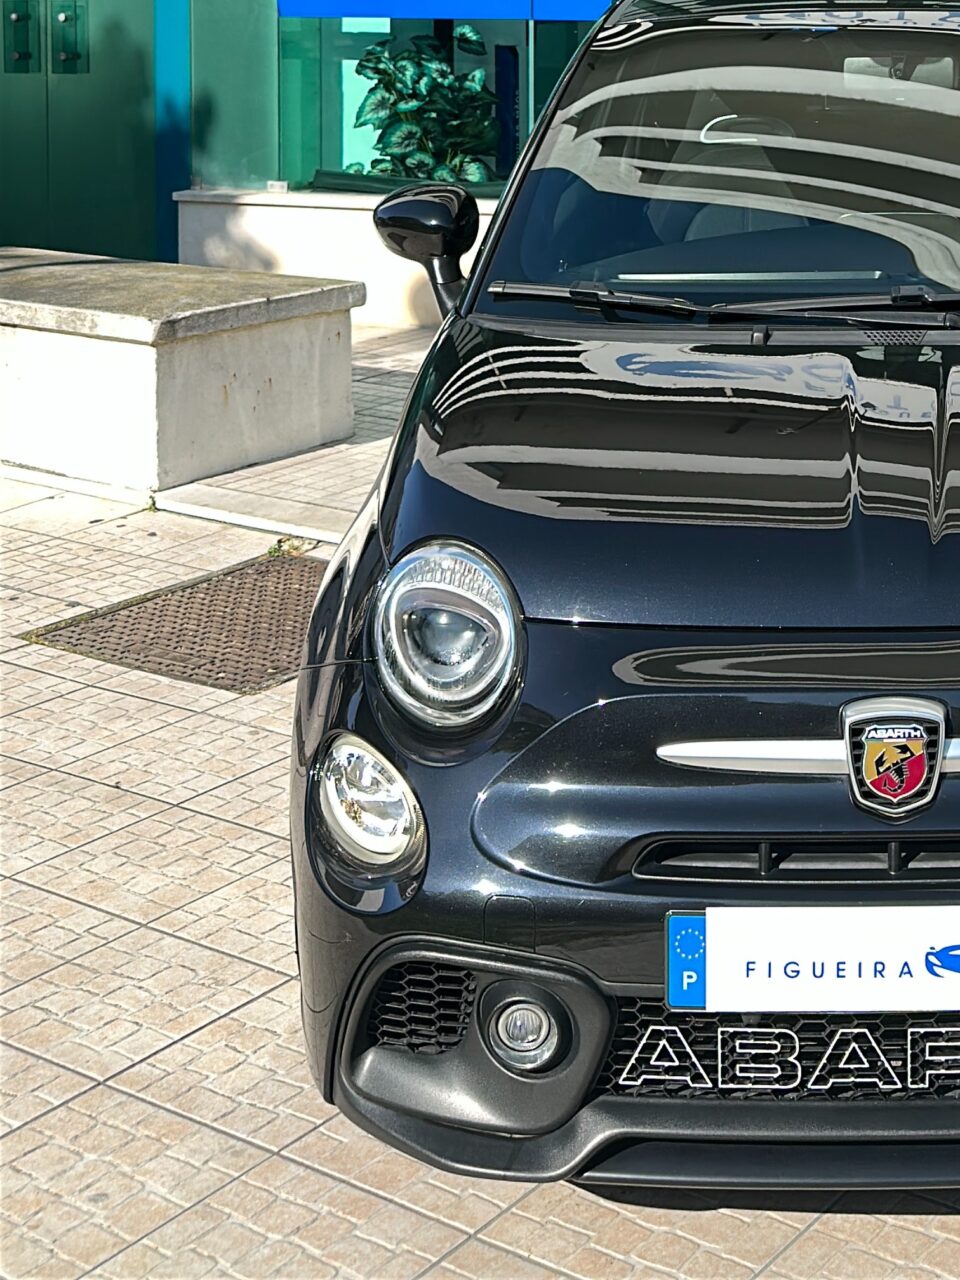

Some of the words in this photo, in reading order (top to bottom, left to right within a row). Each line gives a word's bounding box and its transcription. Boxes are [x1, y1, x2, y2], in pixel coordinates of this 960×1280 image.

[867, 729, 921, 739] ABARTH
[745, 960, 914, 979] FIGUEIRA
[682, 970, 698, 990] P
